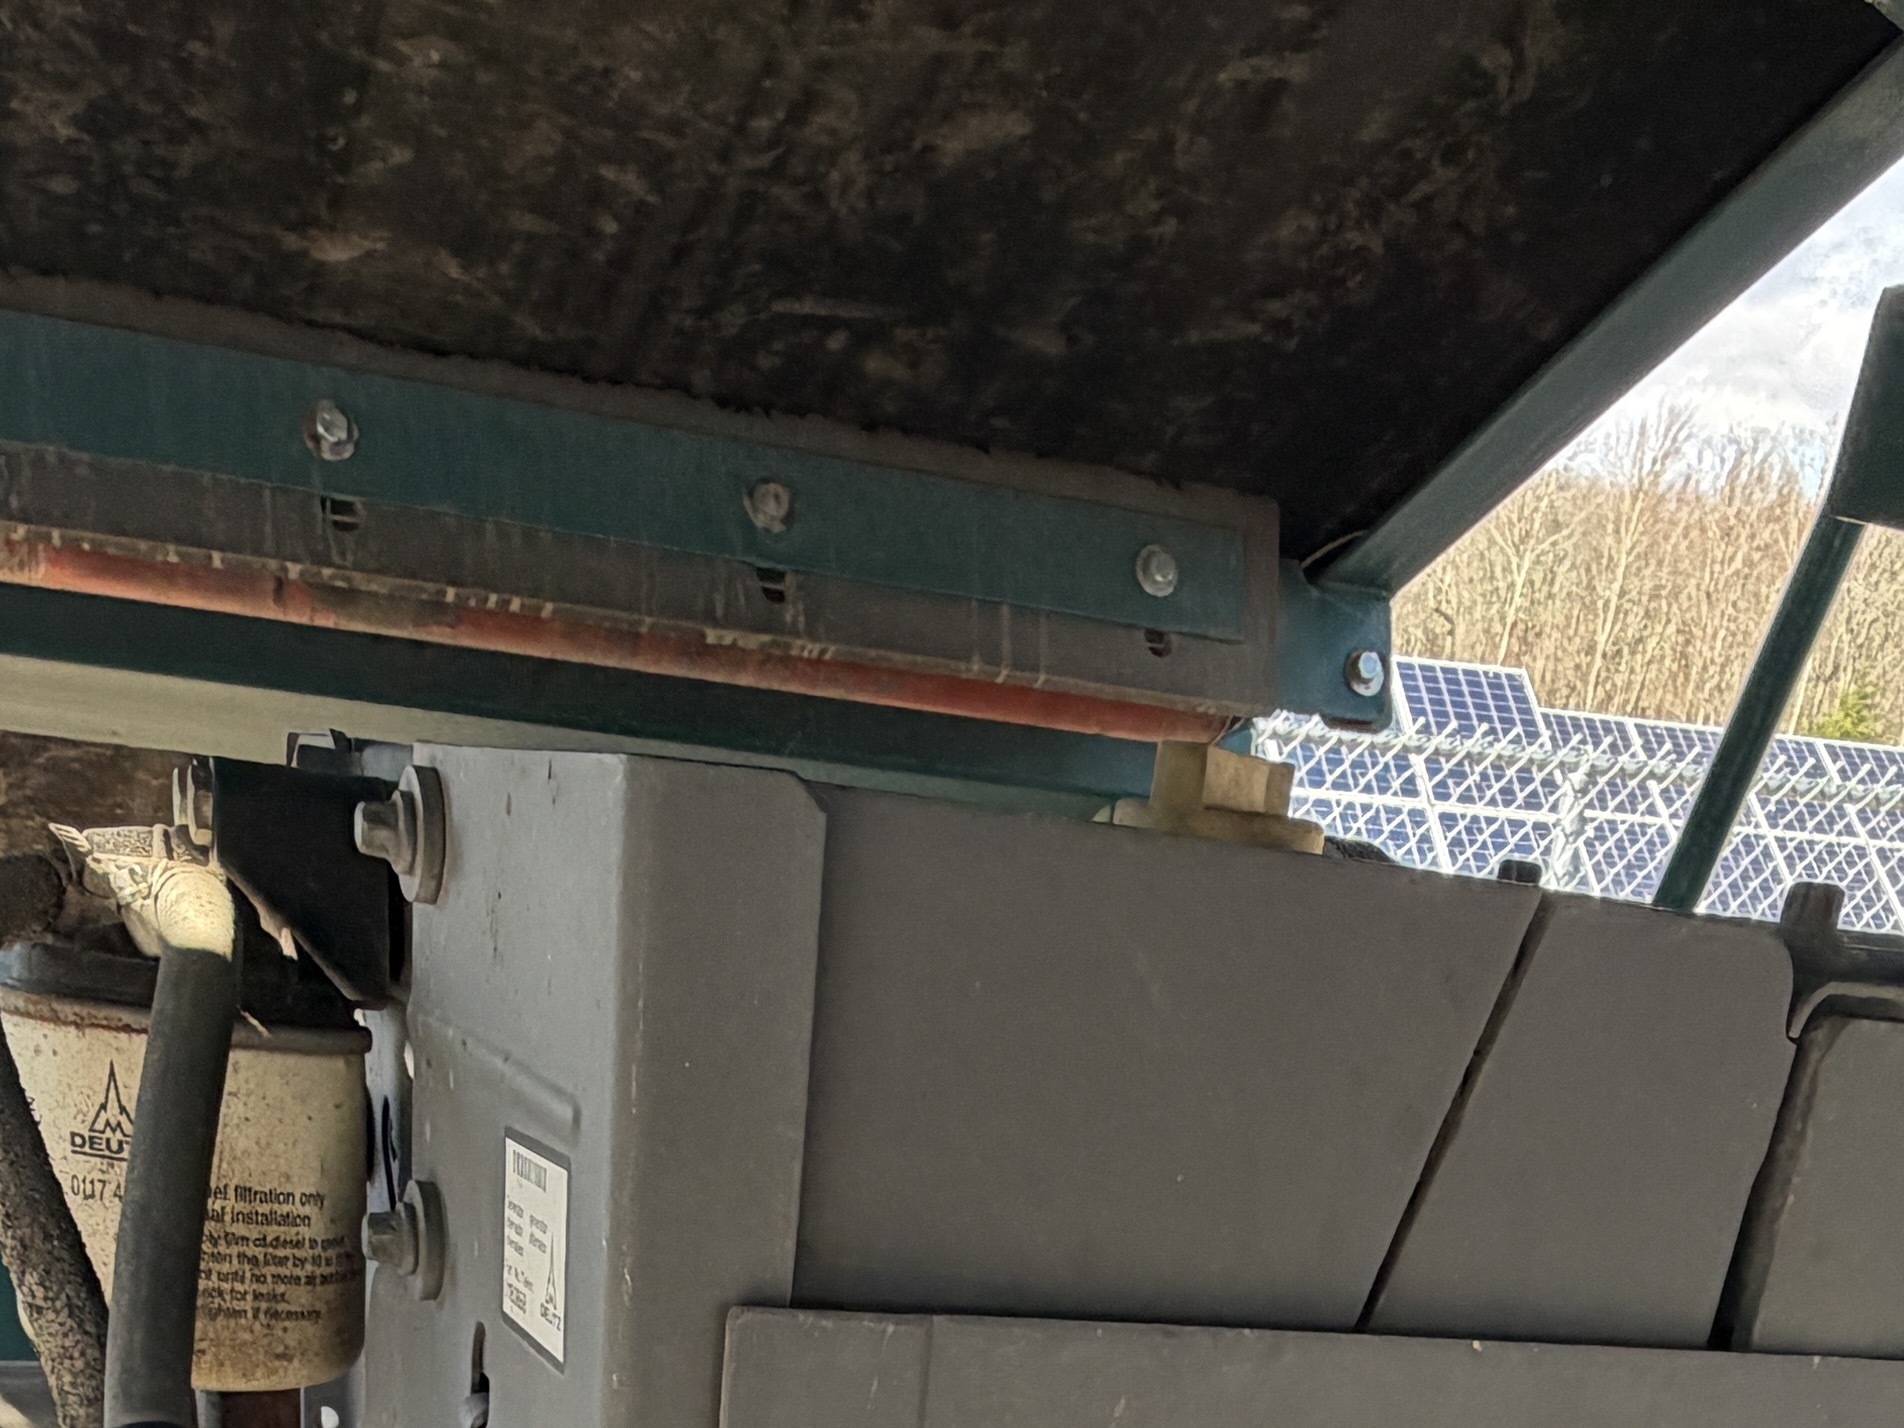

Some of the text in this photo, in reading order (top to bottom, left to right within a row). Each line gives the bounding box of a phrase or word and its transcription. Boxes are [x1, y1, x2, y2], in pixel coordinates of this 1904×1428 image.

[234, 1184, 296, 1207] filtration
[299, 1190, 326, 1212] only
[230, 1203, 312, 1228] installation
